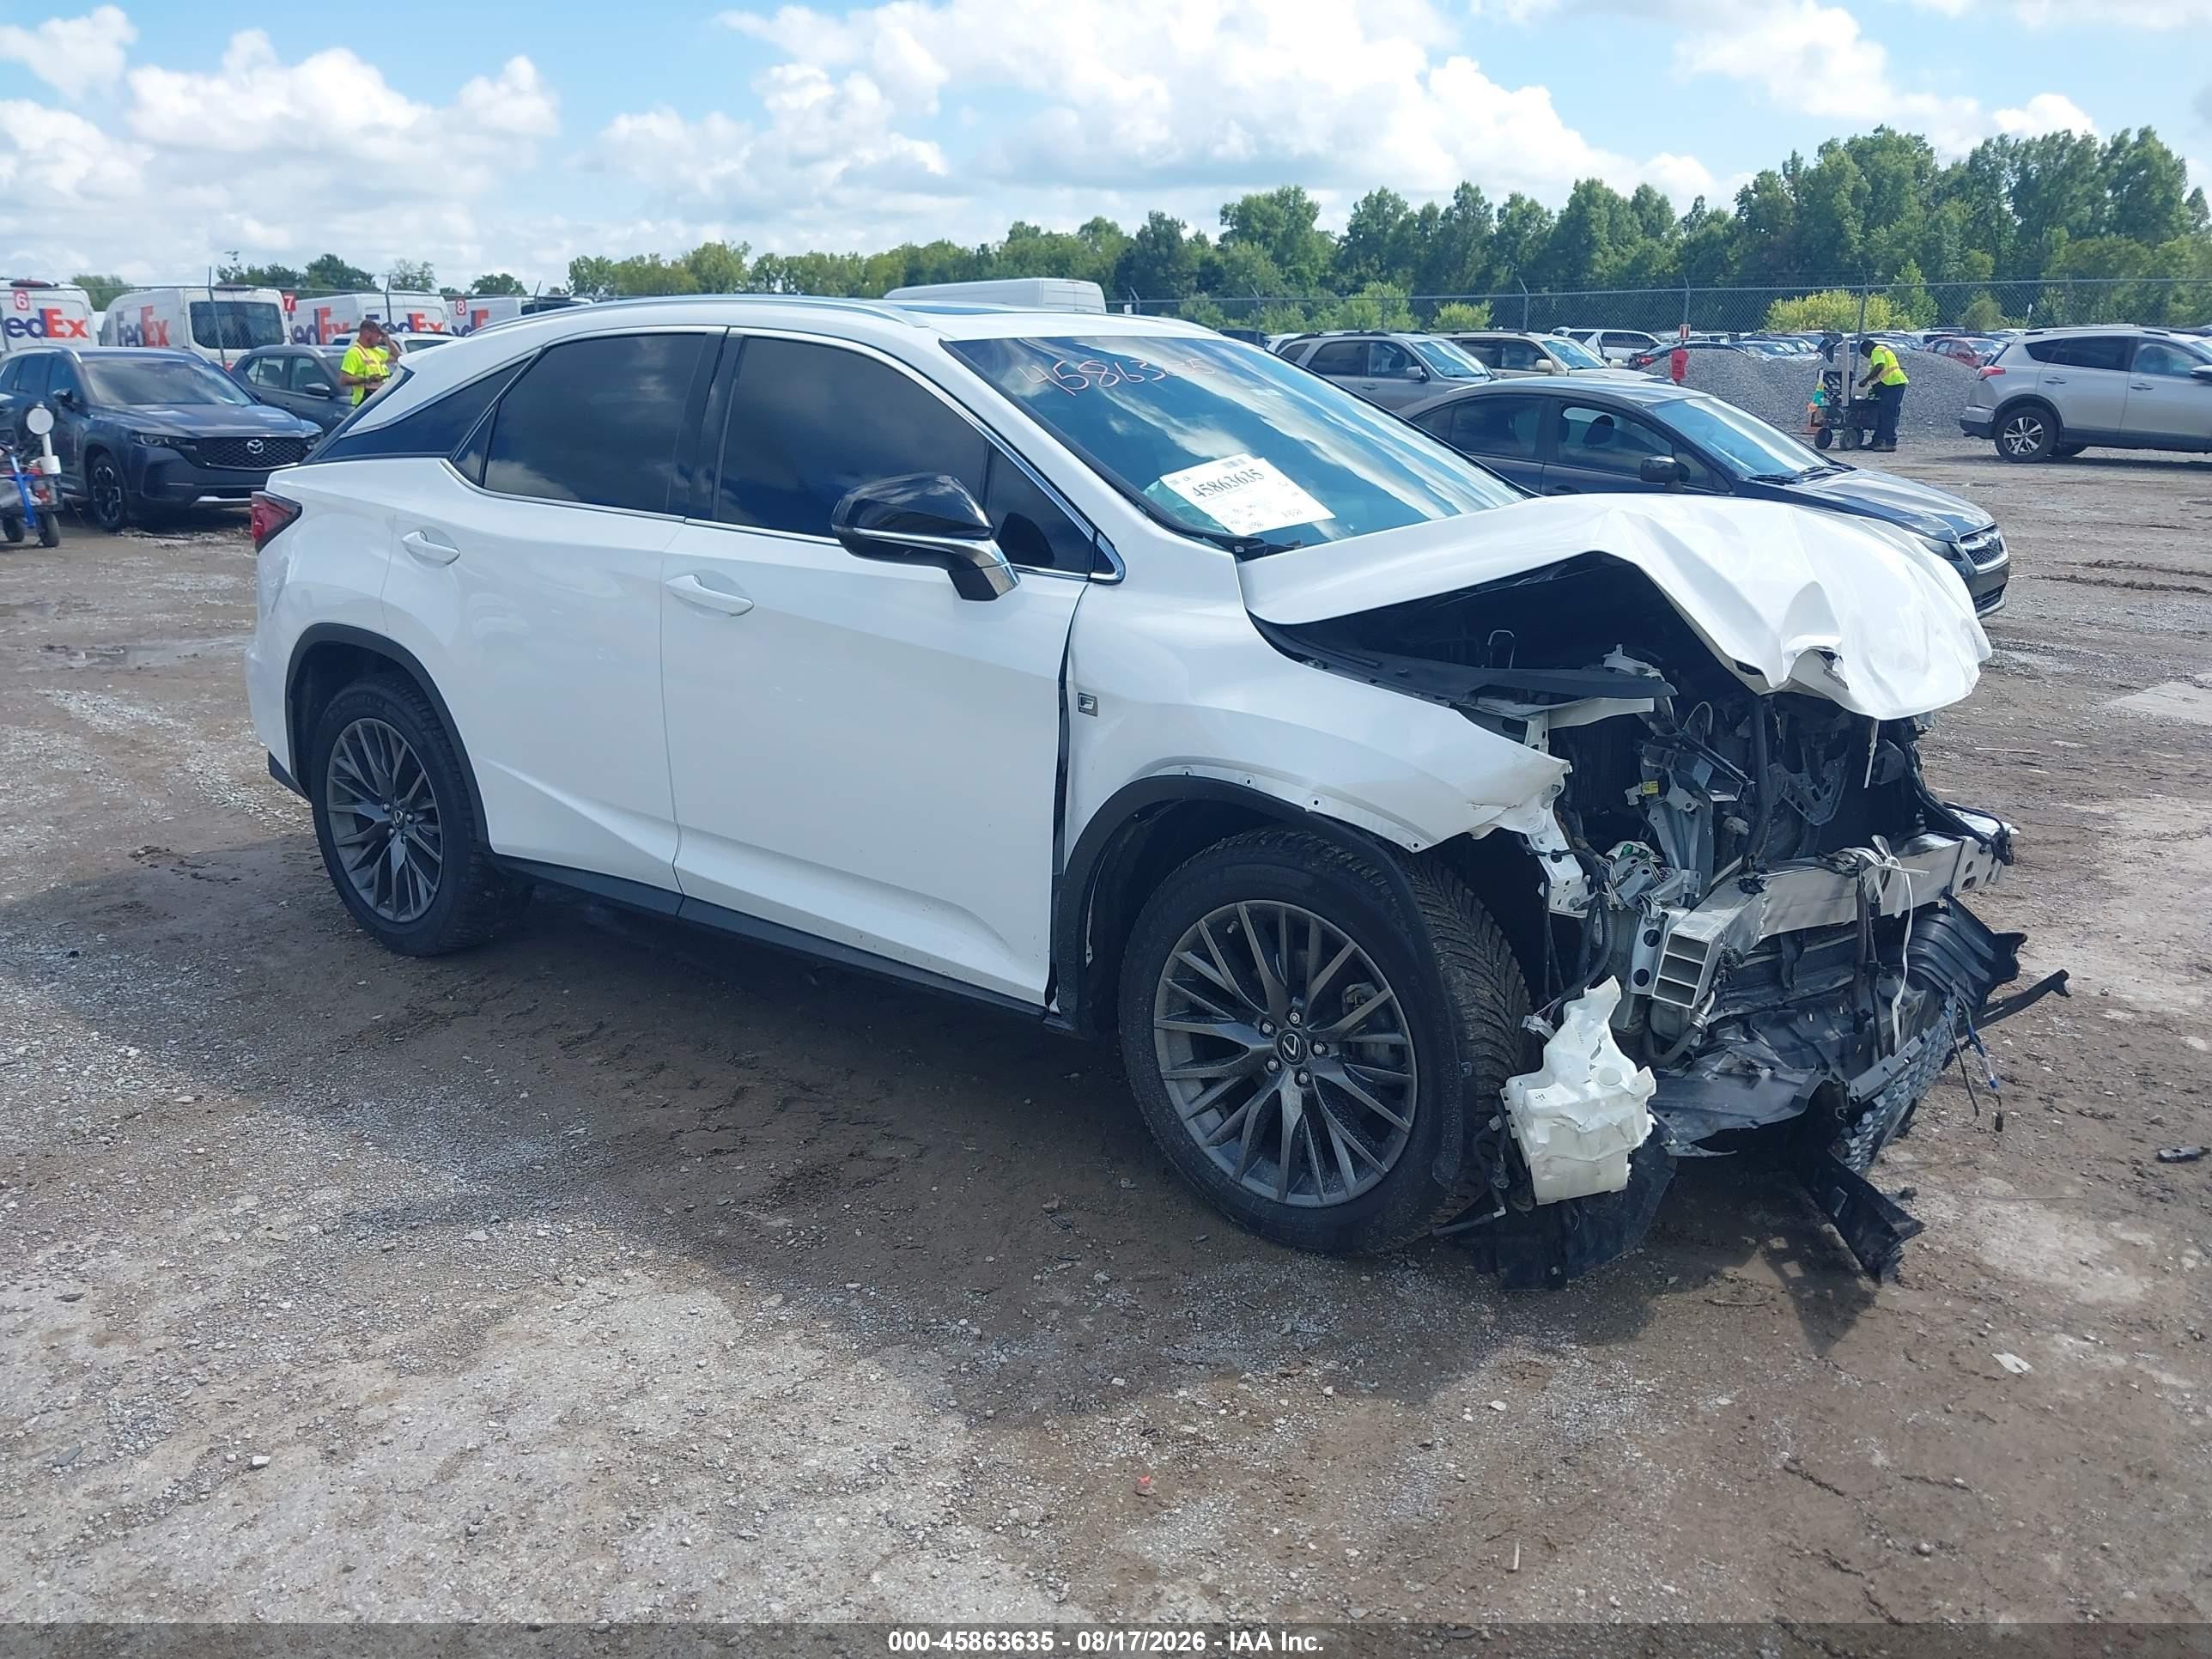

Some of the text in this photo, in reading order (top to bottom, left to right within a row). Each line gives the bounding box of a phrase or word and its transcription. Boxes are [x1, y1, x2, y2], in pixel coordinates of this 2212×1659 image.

[16, 293, 28, 309] 6
[284, 295, 294, 310] 7
[457, 300, 465, 314] 8
[3, 307, 89, 338] edEx
[1192, 469, 1265, 497] 45863635
